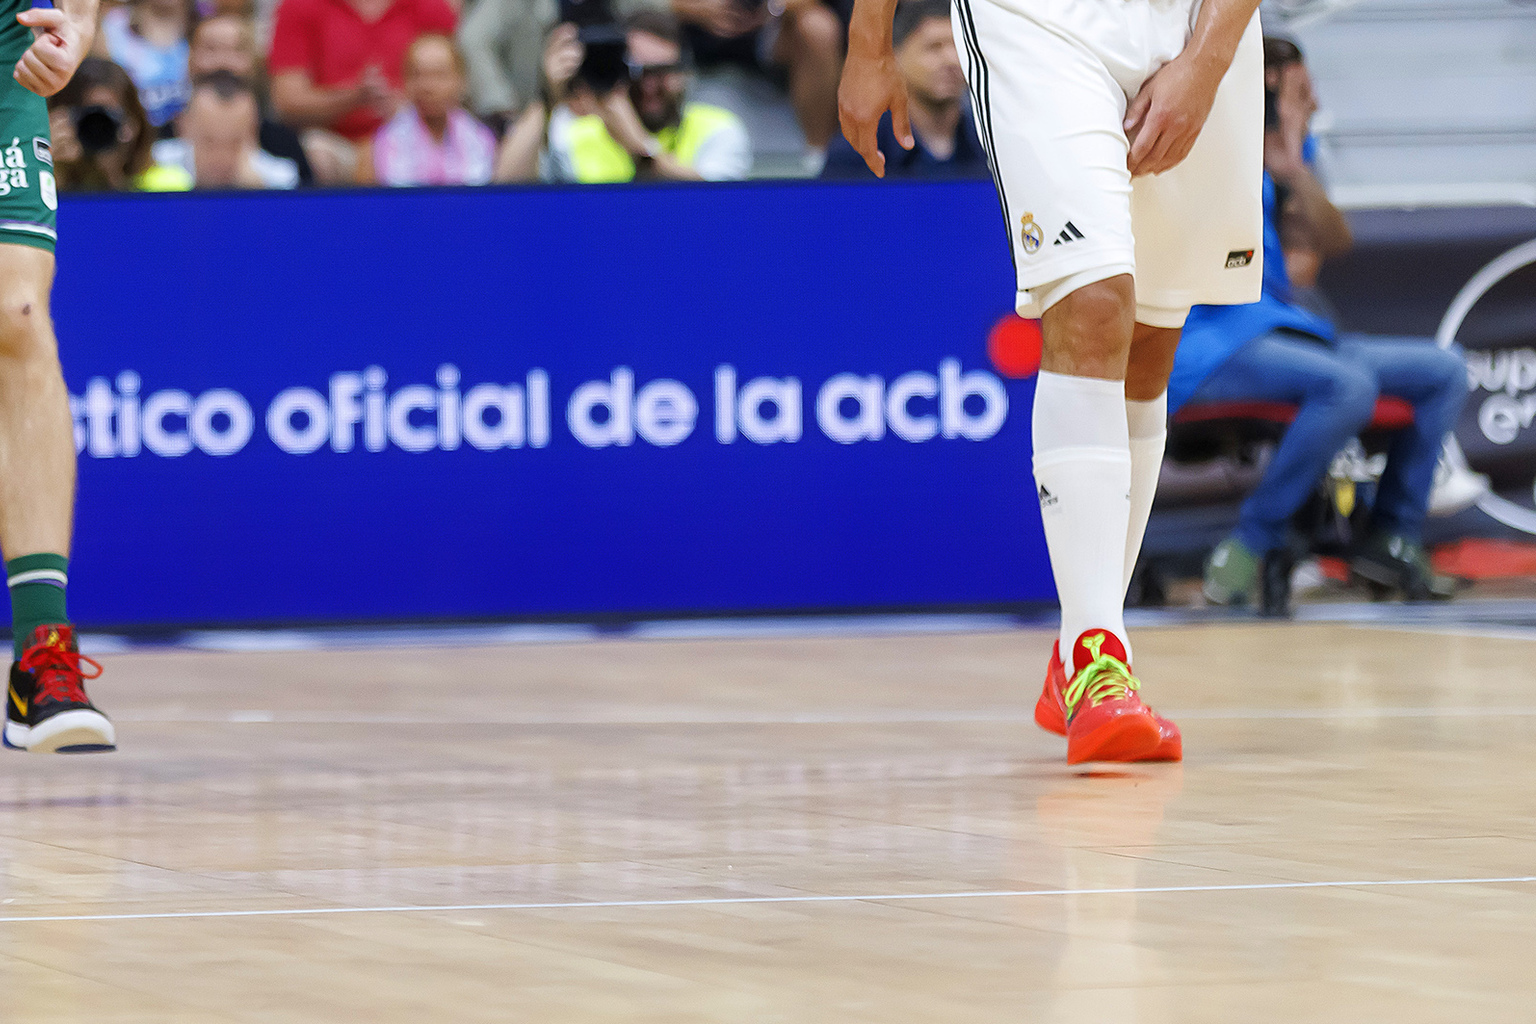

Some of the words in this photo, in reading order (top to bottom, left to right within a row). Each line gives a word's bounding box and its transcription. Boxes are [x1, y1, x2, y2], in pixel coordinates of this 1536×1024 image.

[265, 364, 552, 455] oficial
[566, 365, 698, 447] de
[714, 363, 804, 445] la
[816, 357, 1009, 445] acb
